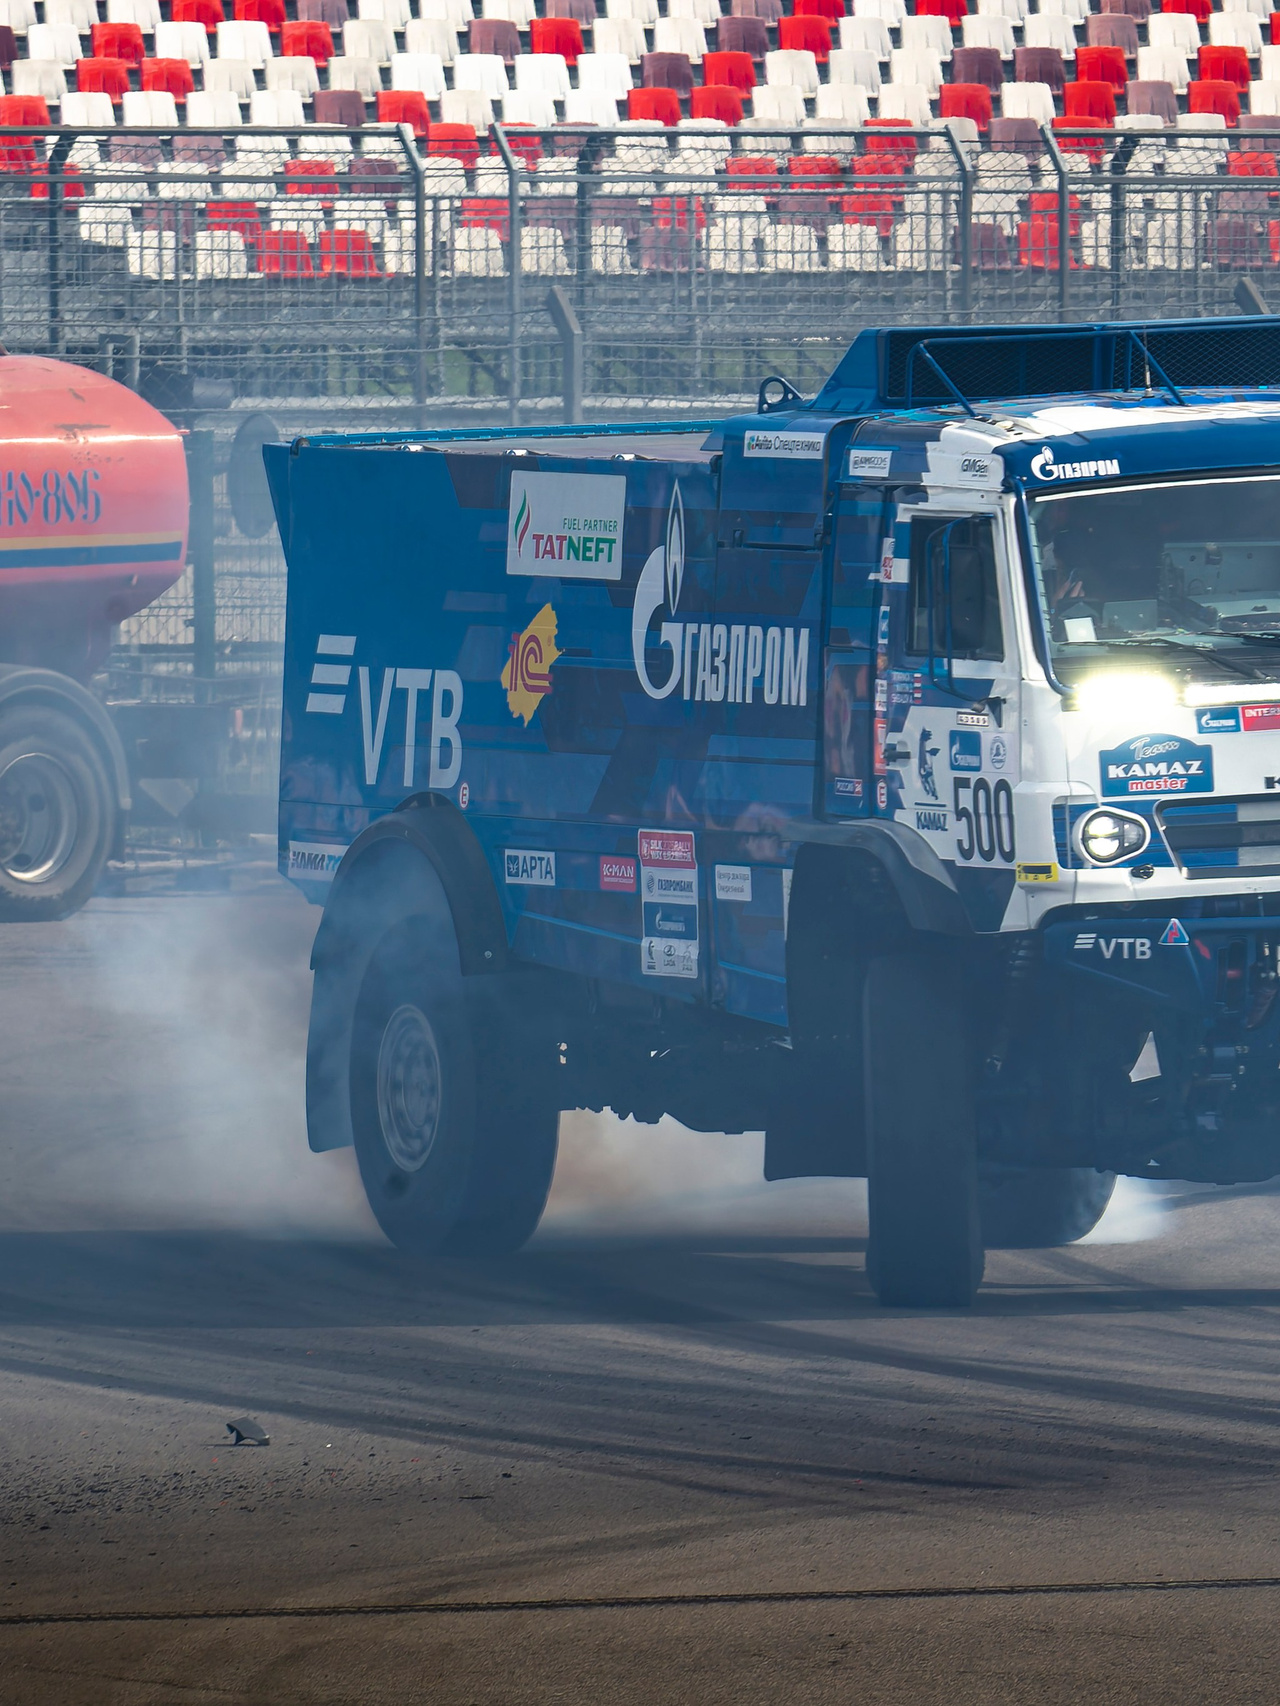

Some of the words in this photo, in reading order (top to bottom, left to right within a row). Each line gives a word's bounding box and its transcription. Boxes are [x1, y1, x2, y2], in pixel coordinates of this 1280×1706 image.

[1059, 459, 1121, 479] ГАЗПРОМ
[562, 517, 581, 531] FUEL
[582, 518, 618, 533] PARTNER
[532, 533, 617, 563] TATNEFT
[682, 624, 810, 707] ГАЗПРОМ
[359, 666, 463, 790] VTB
[1130, 736, 1180, 760] Team
[1107, 759, 1204, 779] KAMAZ
[1128, 776, 1188, 792] master
[916, 810, 948, 832] KAMAZ
[953, 776, 1016, 863] 500
[519, 855, 554, 880] АРТА
[1098, 938, 1152, 960] VTB
